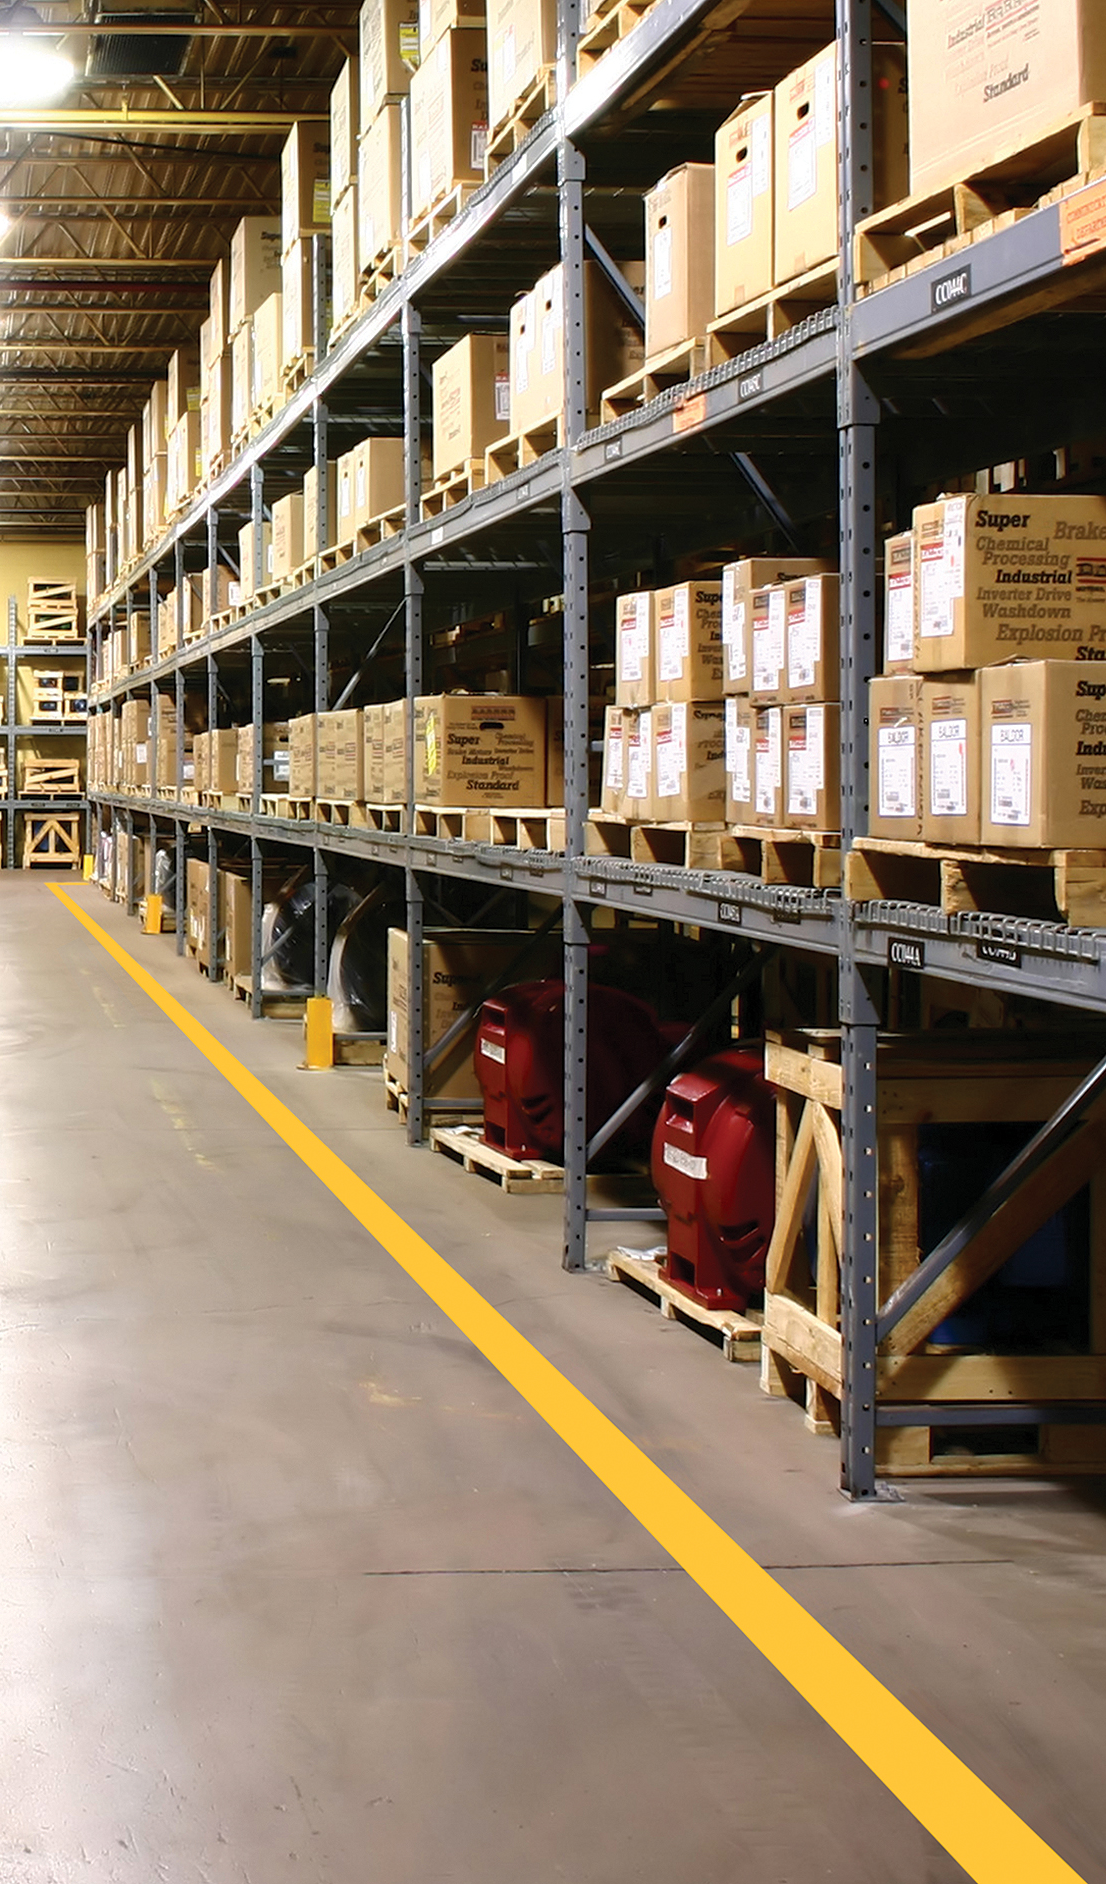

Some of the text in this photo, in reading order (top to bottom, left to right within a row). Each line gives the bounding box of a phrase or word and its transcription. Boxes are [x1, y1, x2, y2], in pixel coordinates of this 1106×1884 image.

[983, 63, 1030, 103] Standard
[975, 510, 1030, 532] Super
[1053, 521, 1106, 540] Brake
[976, 536, 1049, 551] Chemical
[982, 552, 1071, 569] Processing
[995, 569, 1072, 584] Industrial
[976, 587, 1032, 600] Inverter
[1035, 587, 1072, 600] Drive
[982, 603, 1072, 619] Washdown
[996, 624, 1083, 645] Explosion
[447, 733, 480, 747] Super
[462, 756, 509, 765] Industrial
[466, 780, 519, 790] Standard
[891, 942, 922, 967] CC044A
